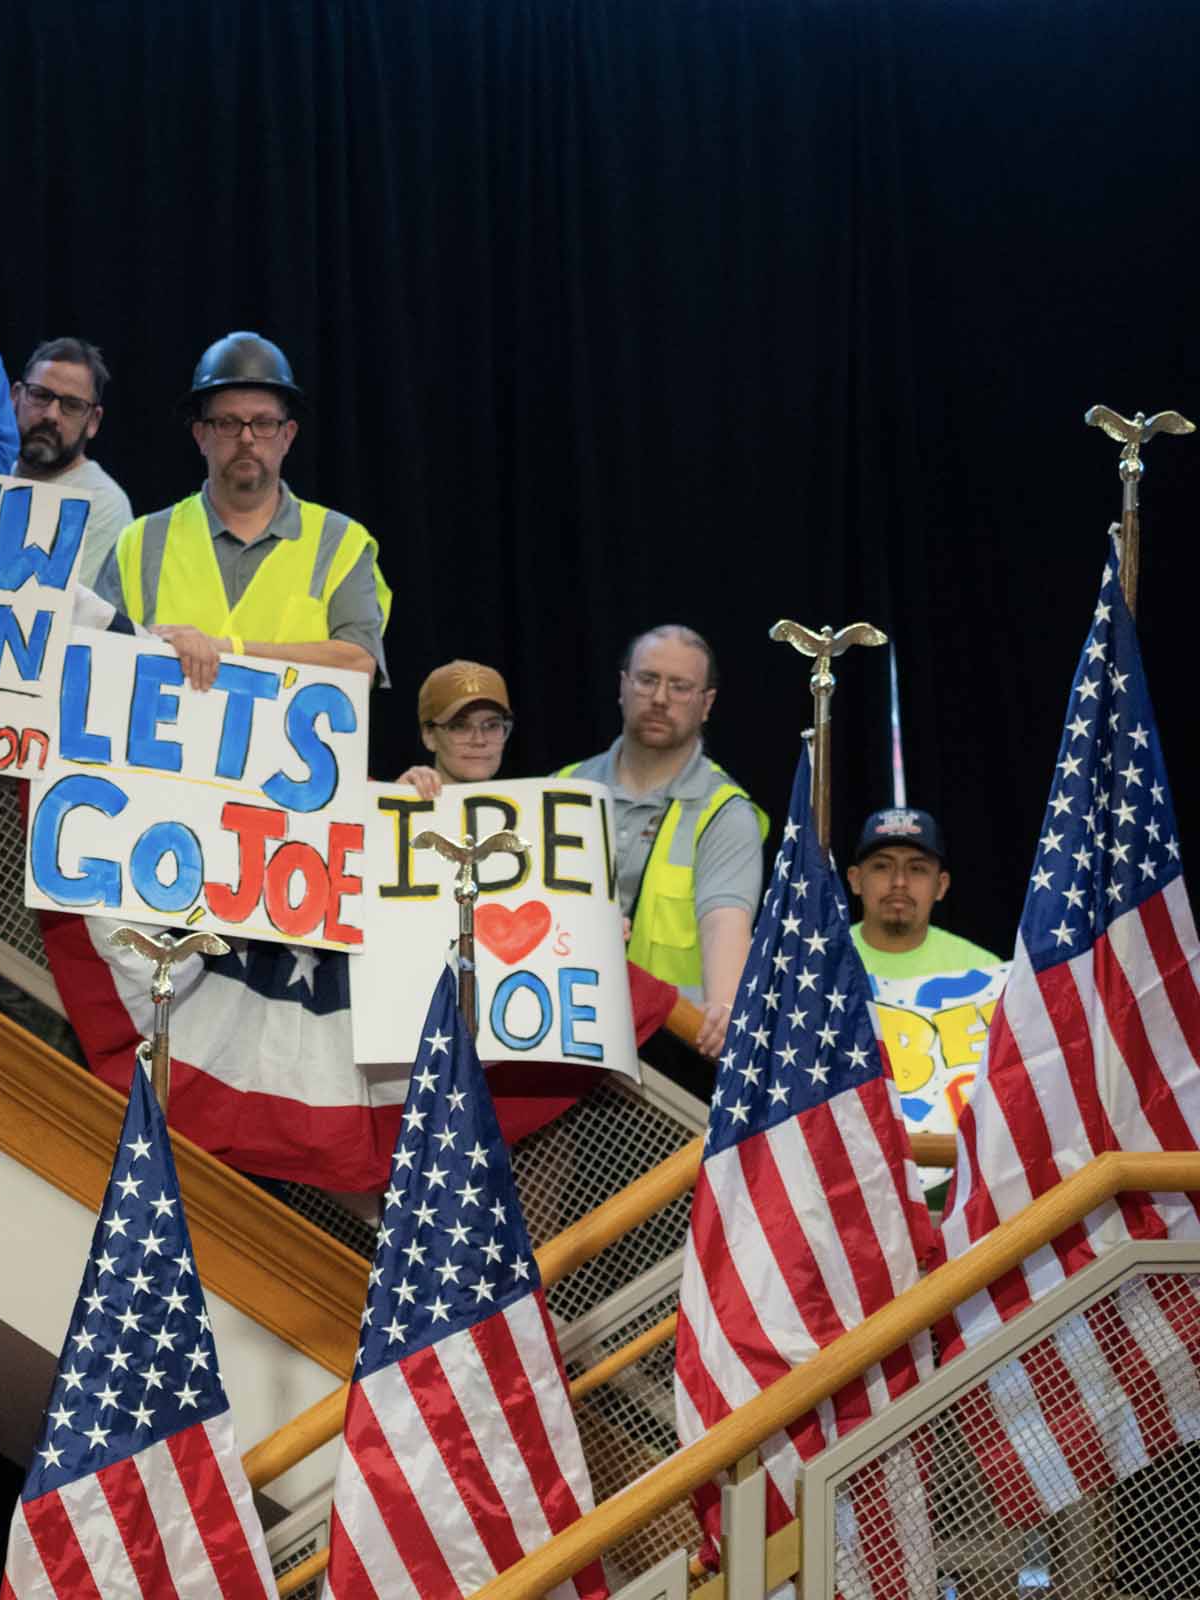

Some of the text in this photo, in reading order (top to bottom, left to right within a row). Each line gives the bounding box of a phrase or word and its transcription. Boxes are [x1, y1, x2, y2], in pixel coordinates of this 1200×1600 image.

[59, 645, 358, 813] LET'S
[203, 801, 365, 945] JOE
[377, 790, 617, 902] IBE
[473, 968, 604, 1062] OE
